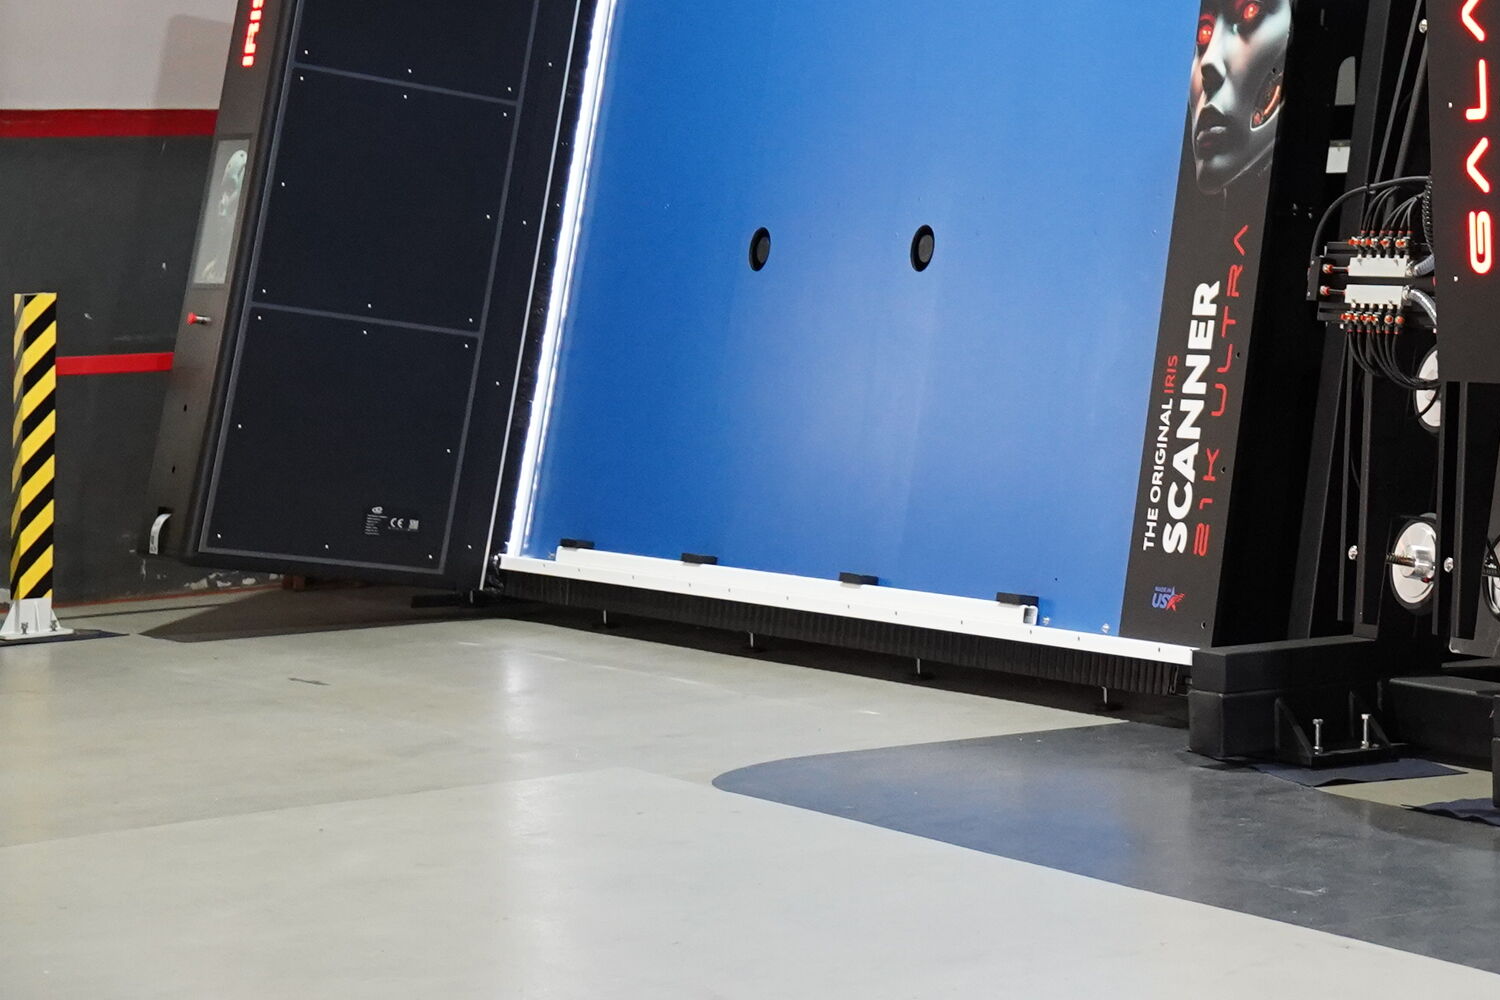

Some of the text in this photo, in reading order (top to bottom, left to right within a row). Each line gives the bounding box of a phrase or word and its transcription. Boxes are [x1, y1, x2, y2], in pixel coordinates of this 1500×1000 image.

[1162, 281, 1221, 554] SCANNER
[1210, 225, 1249, 417] ULTRA
[1142, 354, 1179, 551] THE ORIGINAL IRIS
